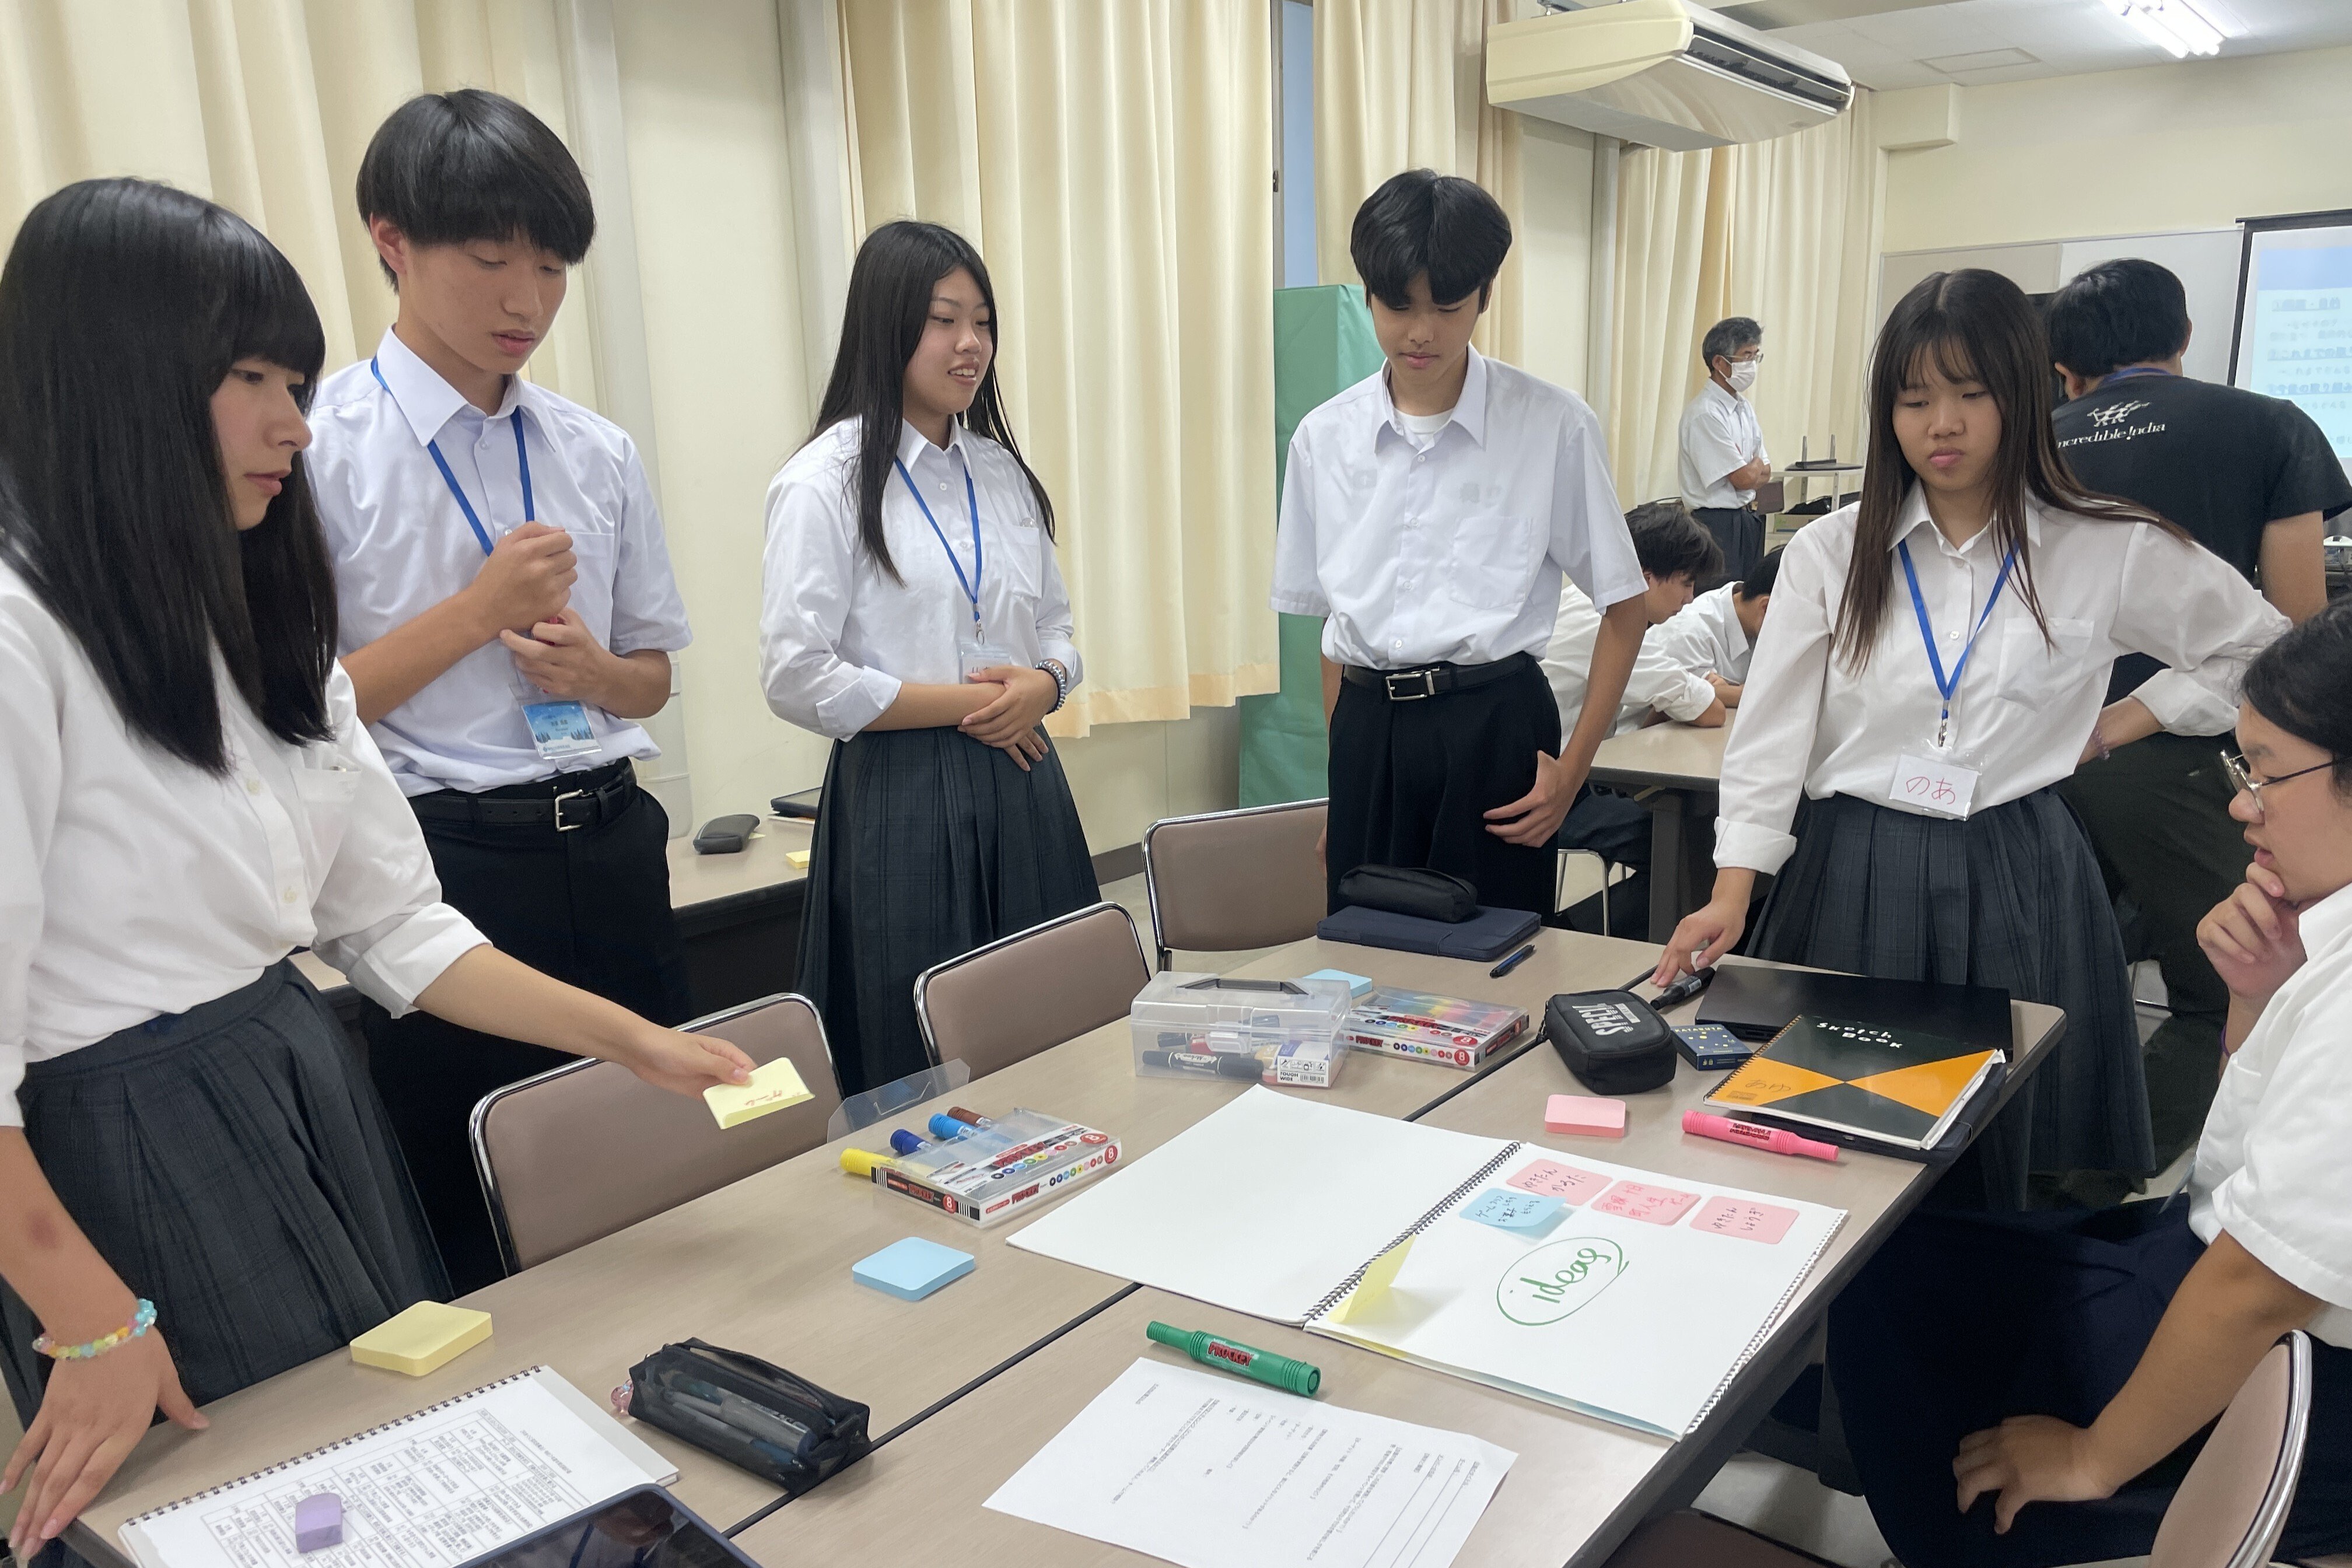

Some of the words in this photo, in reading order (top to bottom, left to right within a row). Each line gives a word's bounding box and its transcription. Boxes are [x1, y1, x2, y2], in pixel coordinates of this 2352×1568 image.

[2058, 429, 2126, 448] ncredible
[1906, 776, 1956, 805] のあ
[1459, 1051, 1466, 1061] 8
[1108, 1147, 1114, 1159] 8
[1522, 1169, 1558, 1188] ゆきたん
[946, 1196, 953, 1209] 8
[1711, 1208, 1738, 1229] ゆきたん
[1207, 1341, 1254, 1367] PROCKEY
